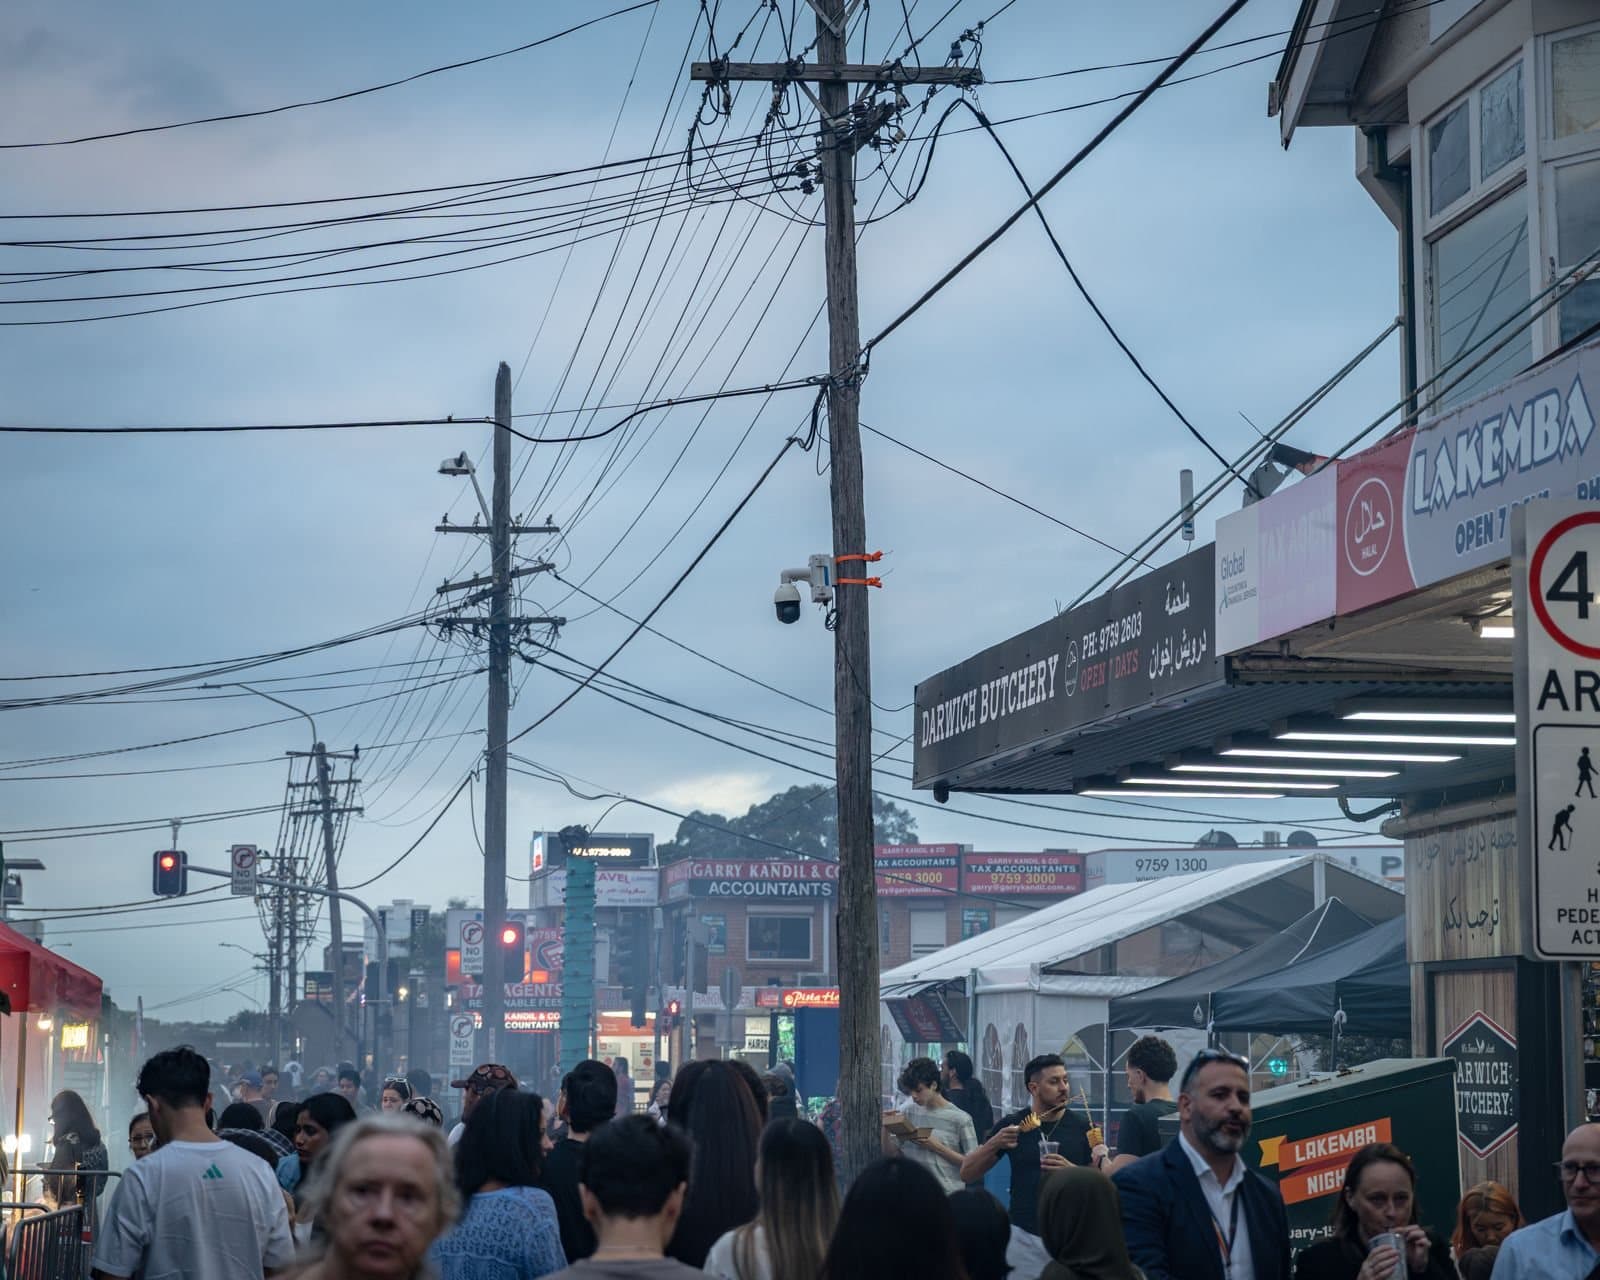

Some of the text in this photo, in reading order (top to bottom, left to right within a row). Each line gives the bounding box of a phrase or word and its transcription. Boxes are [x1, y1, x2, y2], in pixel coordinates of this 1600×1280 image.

[1413, 371, 1596, 517] LAKEMBA
[1354, 500, 1385, 544] حلال
[1455, 506, 1507, 555] OPEN 7
[1220, 547, 1246, 581] Global
[1546, 550, 1594, 619] 4
[1082, 611, 1143, 660] PH: 9759 2603
[1080, 661, 1106, 692] OPEN
[1115, 648, 1140, 679] DAYS
[921, 653, 1060, 748] DARWICH BUTCHERY
[892, 858, 956, 867] ACCOUNTANTS
[970, 865, 1076, 873] TAX ACCOUNTANTS
[1135, 858, 1208, 872] 9759 1300
[598, 872, 630, 884] AVEL
[693, 864, 742, 878] GARRY
[750, 864, 806, 878] KANDIL
[811, 865, 821, 878] &
[885, 871, 943, 885] 9759 3000
[991, 873, 1056, 884] 9759 3000
[709, 881, 833, 896] ACCOUNTANTS
[1558, 908, 1600, 924] PEDE
[466, 947, 480, 956] NO
[503, 984, 562, 997] AGENTS
[547, 1011, 560, 1020] CO
[504, 1021, 560, 1030] COUNTANTS
[454, 1040, 470, 1049] NO
[1457, 1061, 1509, 1085] ARWICH
[1457, 1090, 1510, 1116] UTCHERY
[1295, 1125, 1377, 1163] LAKEMBA
[1307, 1167, 1347, 1195] NIGH
